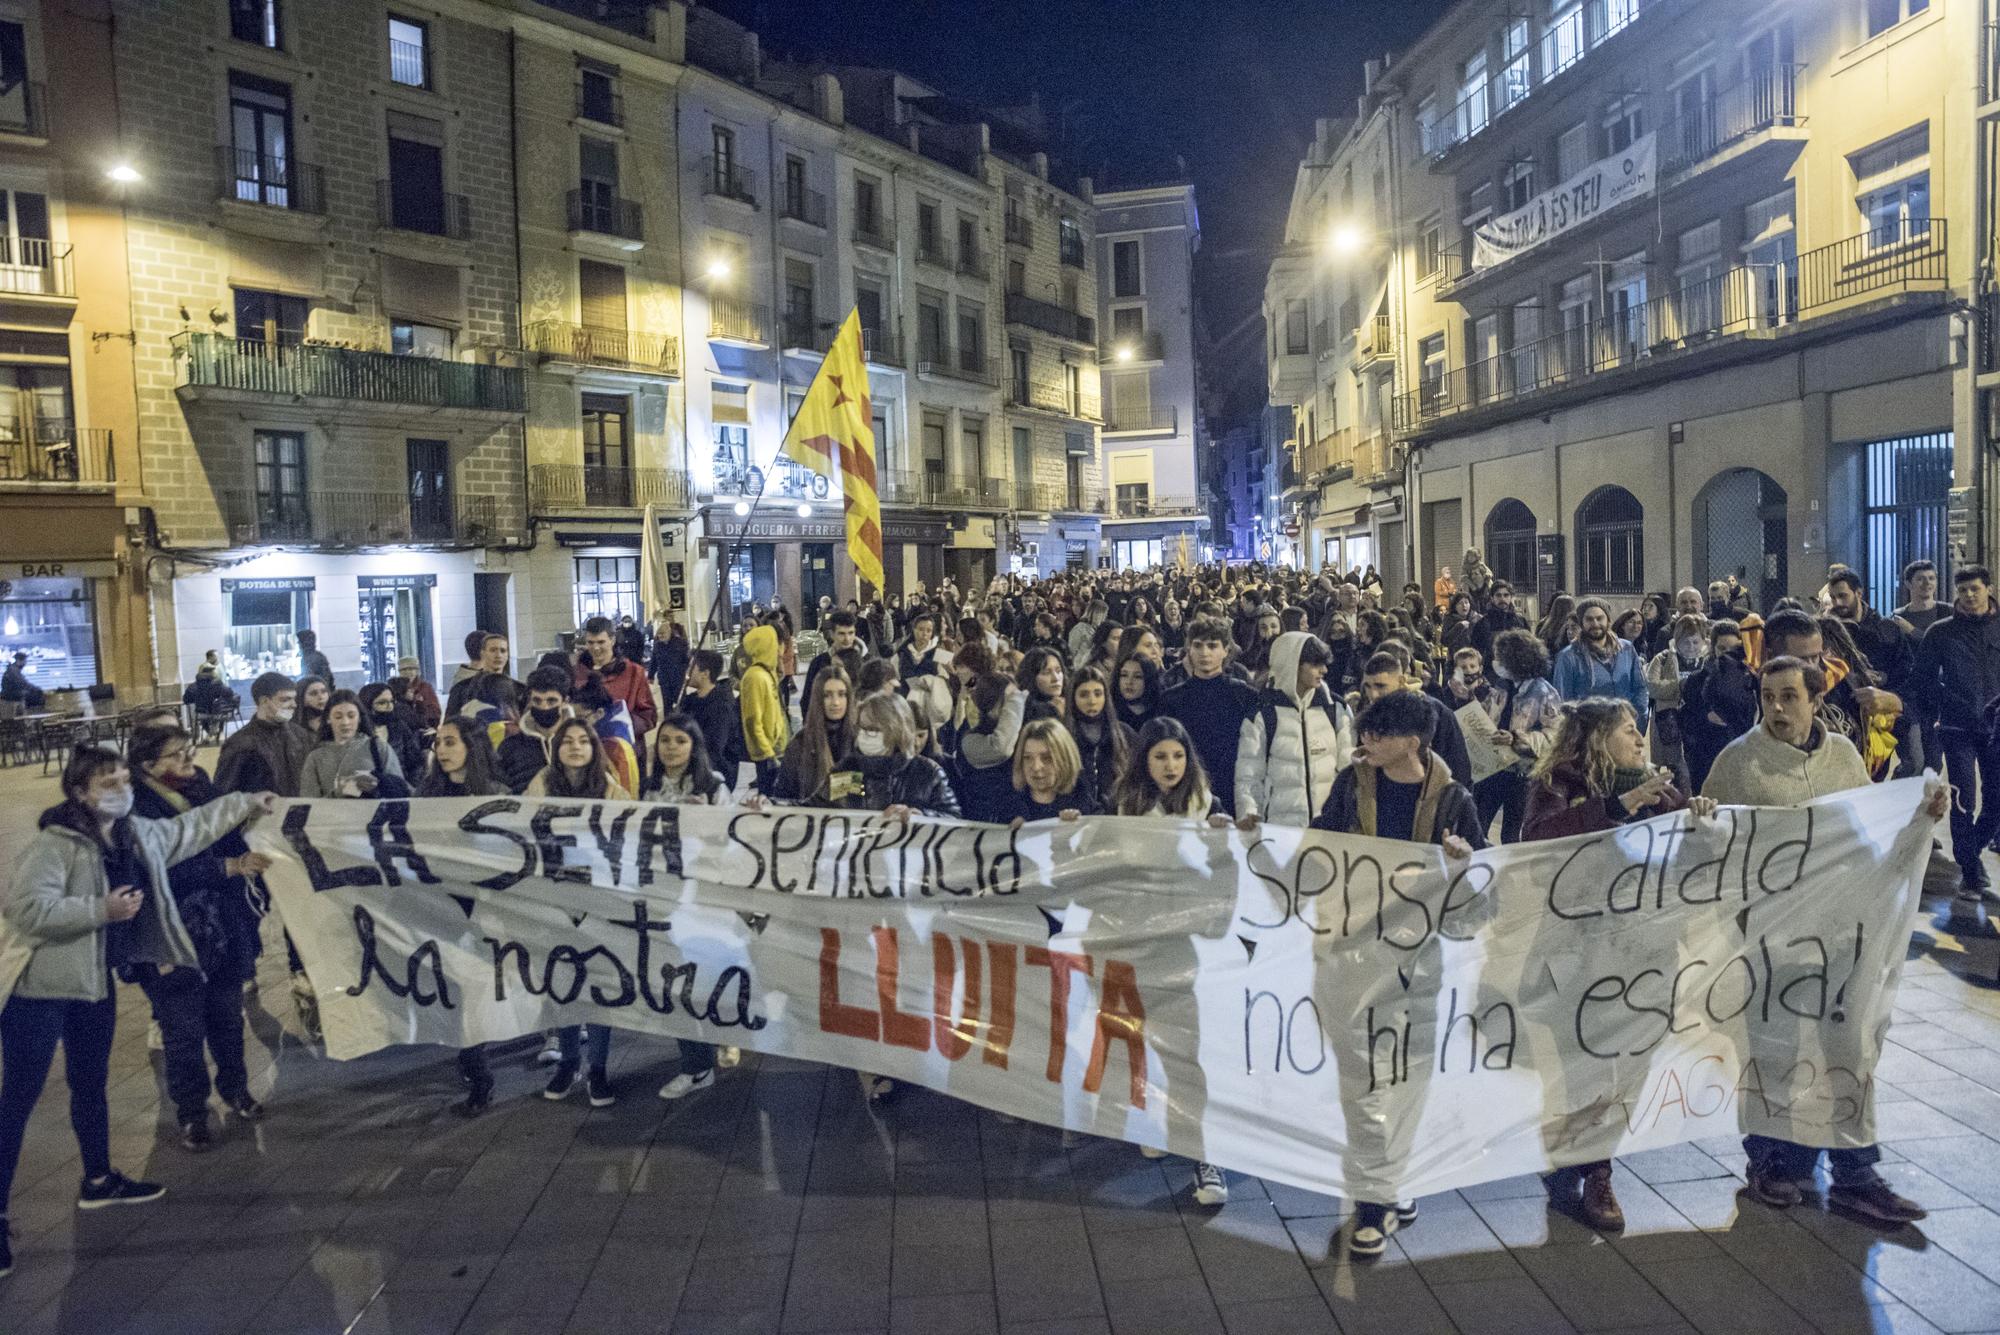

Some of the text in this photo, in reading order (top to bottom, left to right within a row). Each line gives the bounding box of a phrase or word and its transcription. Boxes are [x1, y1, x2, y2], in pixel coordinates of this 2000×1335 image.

[1551, 190, 1568, 231] ÉS
[1572, 174, 1602, 222] TEU
[726, 524, 795, 535] DROGUERIA
[802, 524, 843, 536] FERRER
[883, 526, 917, 537] ARMACIA
[21, 564, 65, 577] BAR
[239, 579, 315, 590] BOTIGA DE VINS
[373, 577, 415, 587] WINE BAR
[281, 800, 442, 893] LA
[457, 799, 684, 890] SEVA
[346, 900, 1146, 1110] la nostra LLUITA
[1245, 922, 1863, 1093] no hi ha escola!
